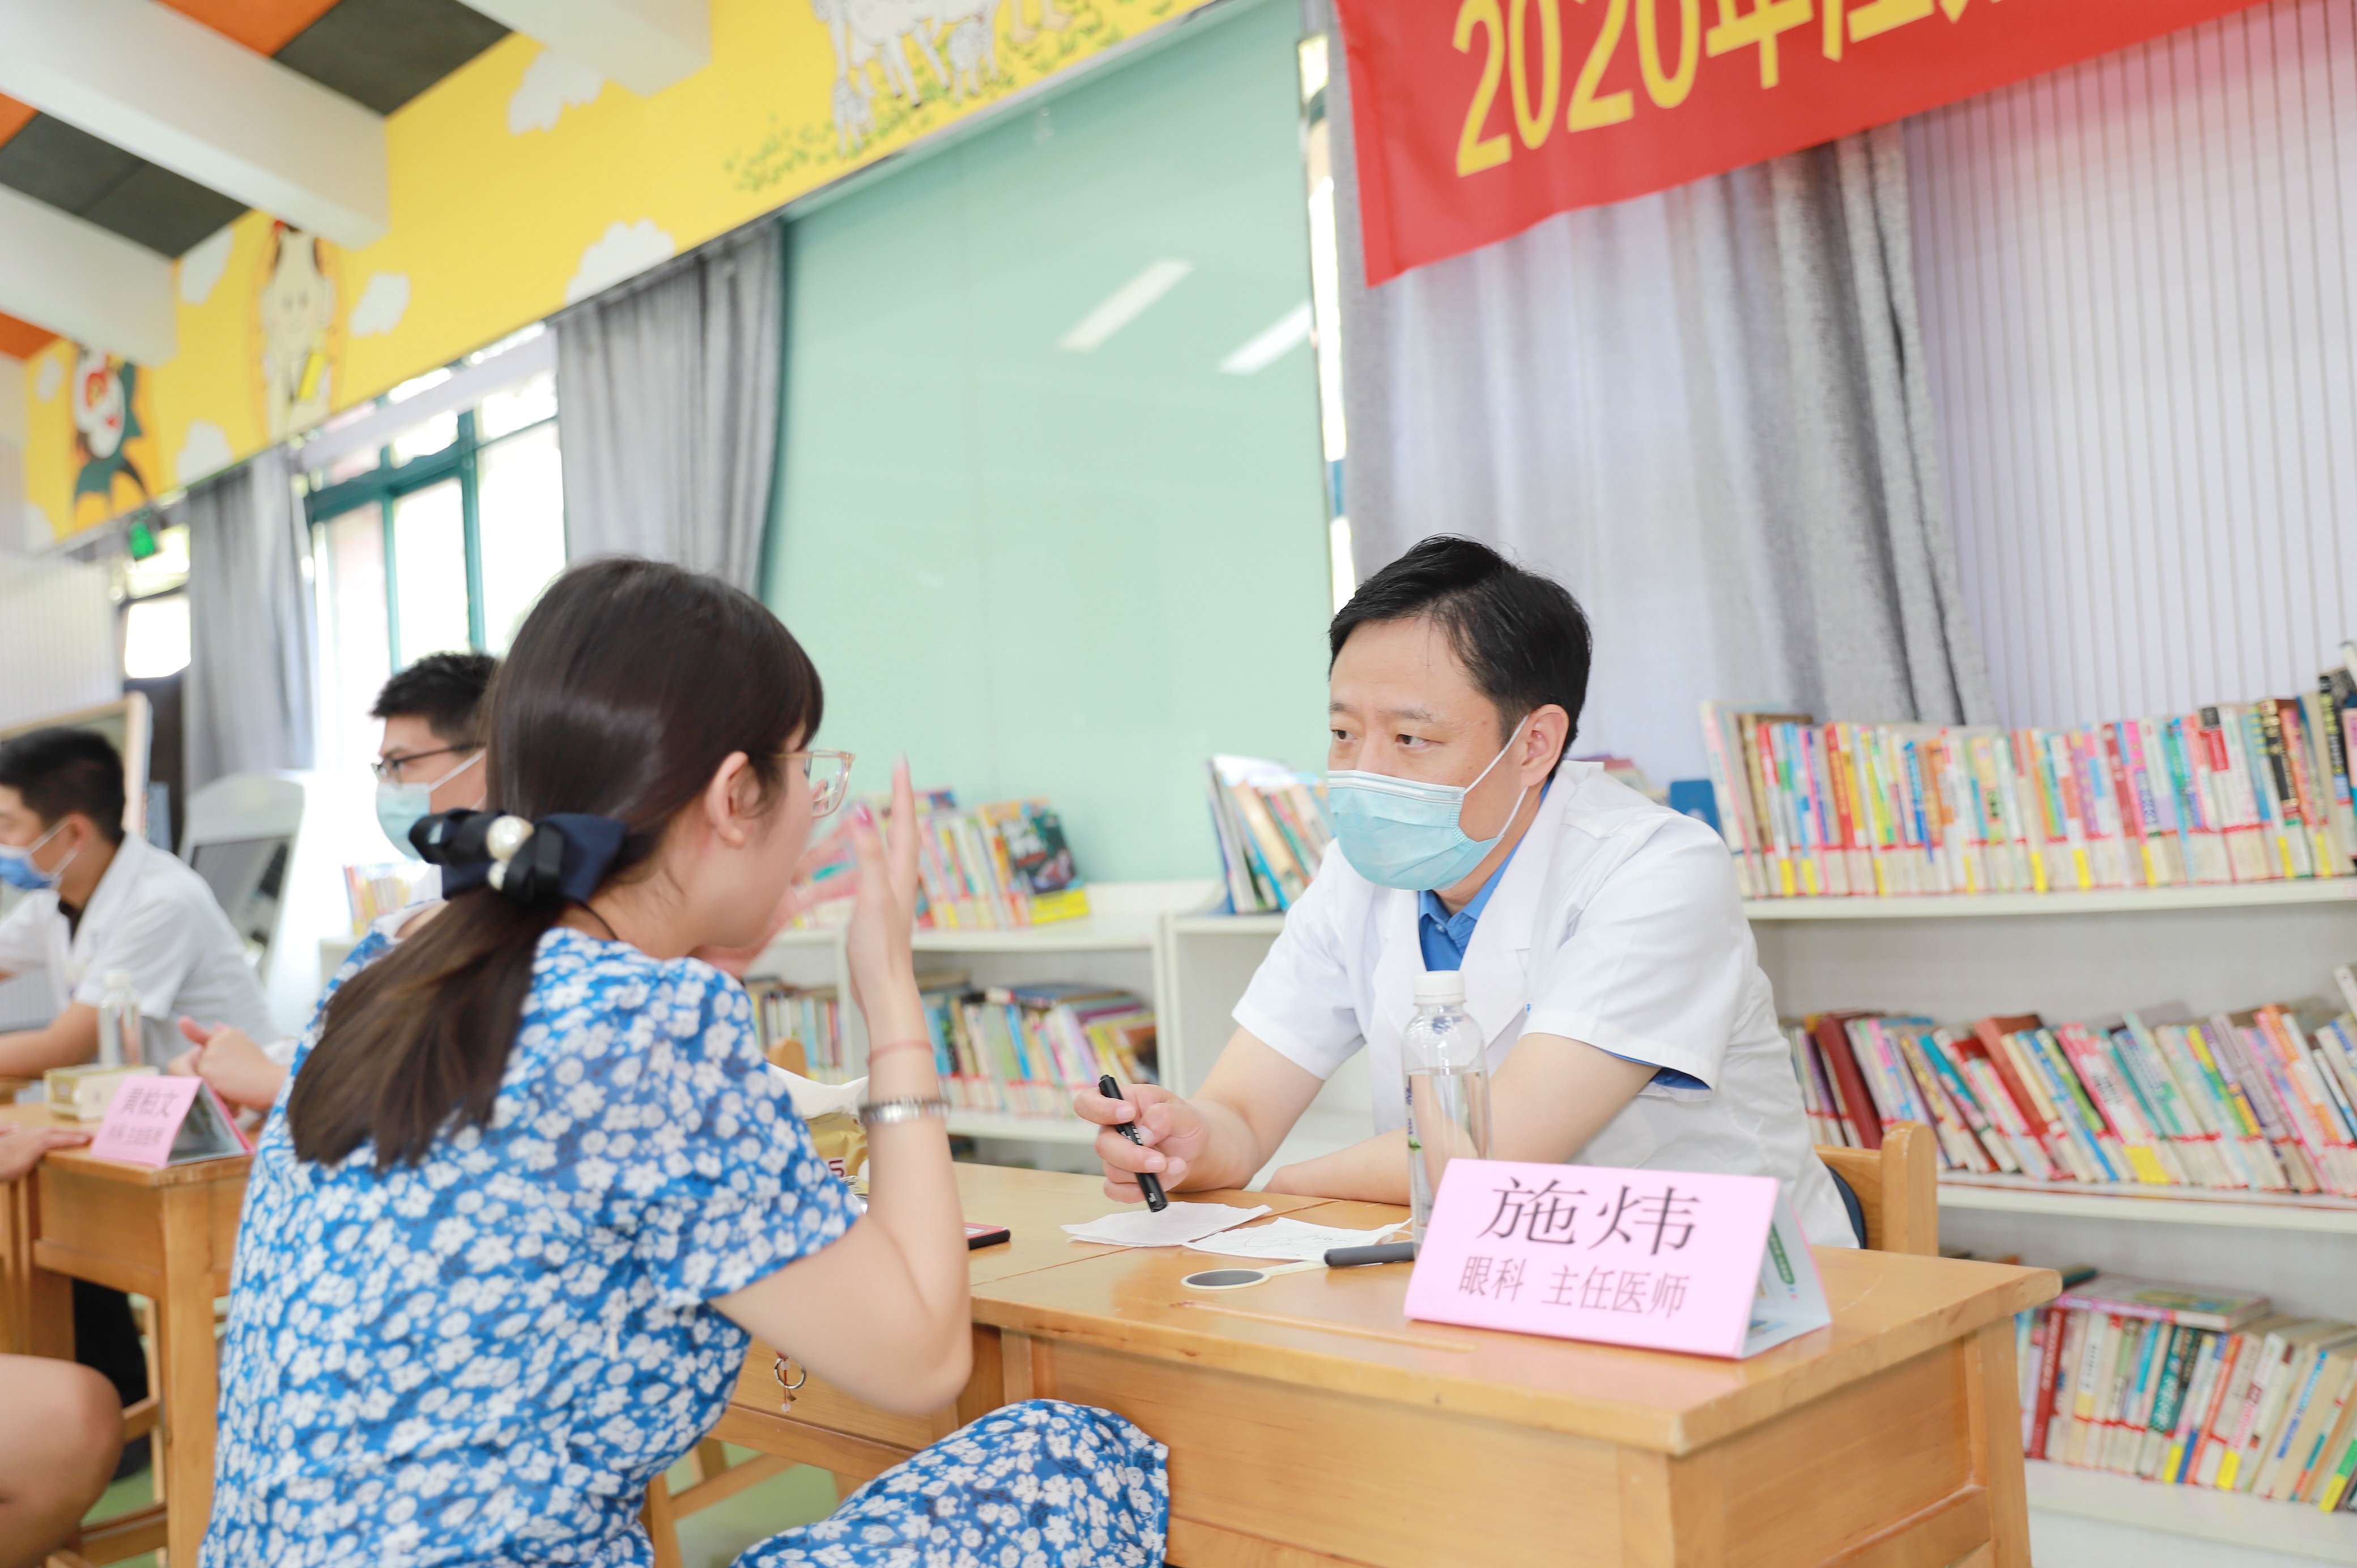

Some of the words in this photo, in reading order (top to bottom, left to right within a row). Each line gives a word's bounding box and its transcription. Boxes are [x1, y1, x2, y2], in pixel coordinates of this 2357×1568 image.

[1477, 1177, 1701, 1256] 施炜
[1458, 1255, 1528, 1302] 眼科
[1542, 1265, 1691, 1319] 主任医师
